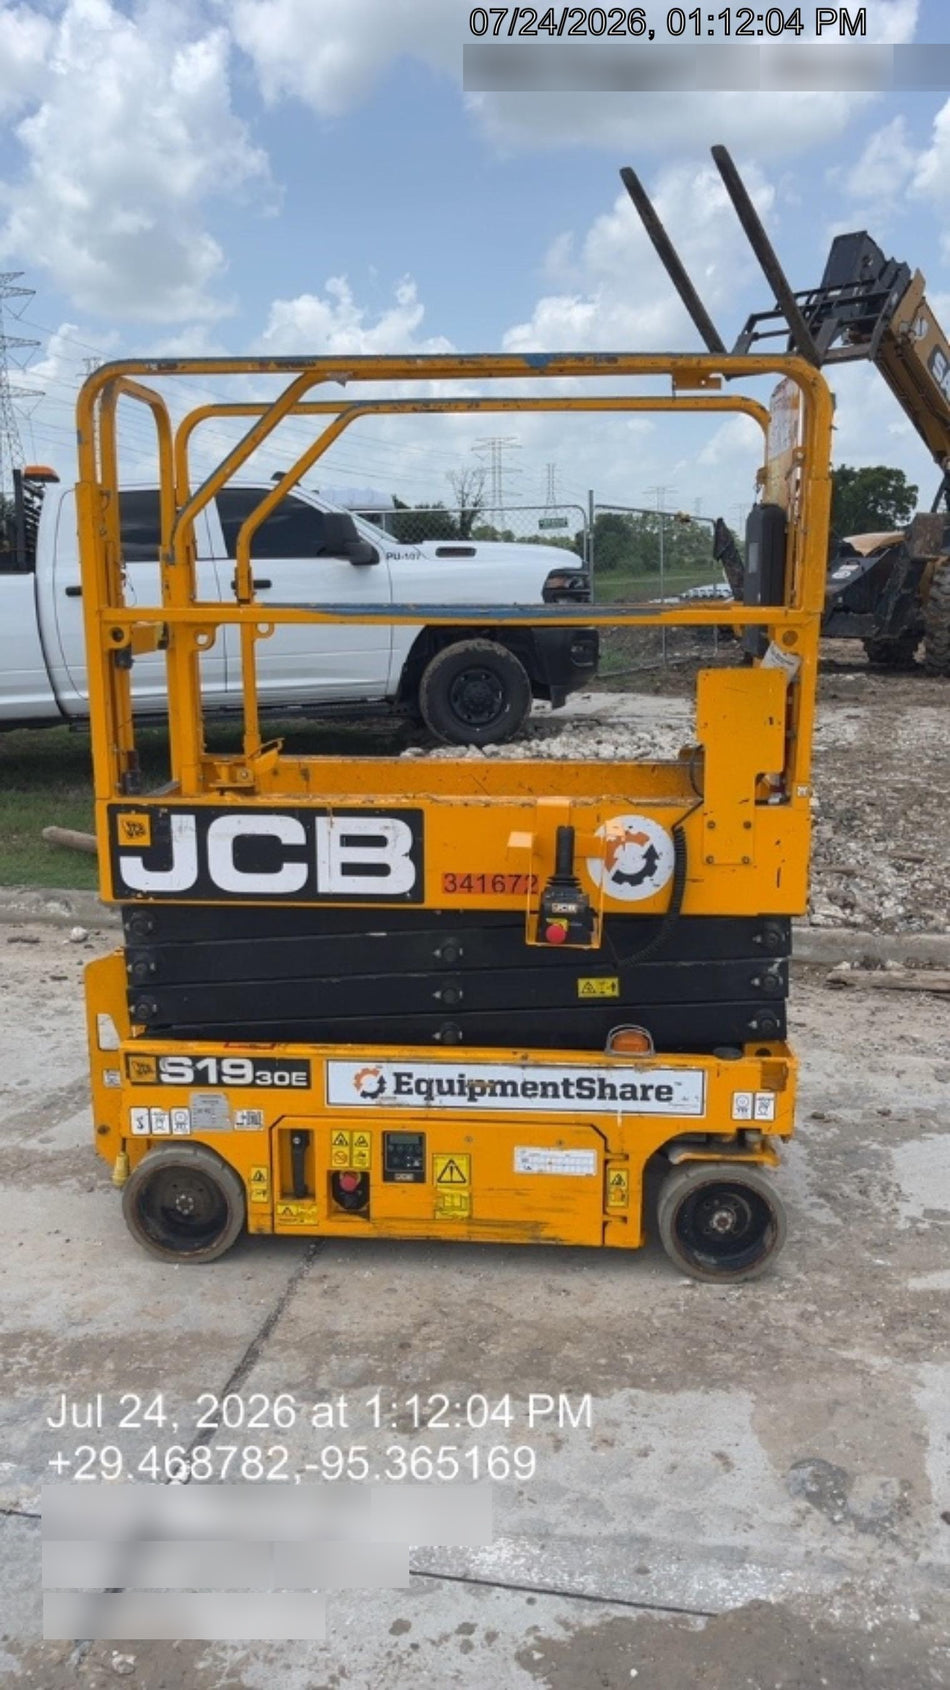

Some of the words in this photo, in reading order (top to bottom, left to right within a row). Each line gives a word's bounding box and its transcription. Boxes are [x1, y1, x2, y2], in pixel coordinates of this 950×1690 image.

[119, 814, 416, 895] JCB
[443, 872, 538, 895] 341672
[393, 1072, 673, 1102] EquipmentShare
